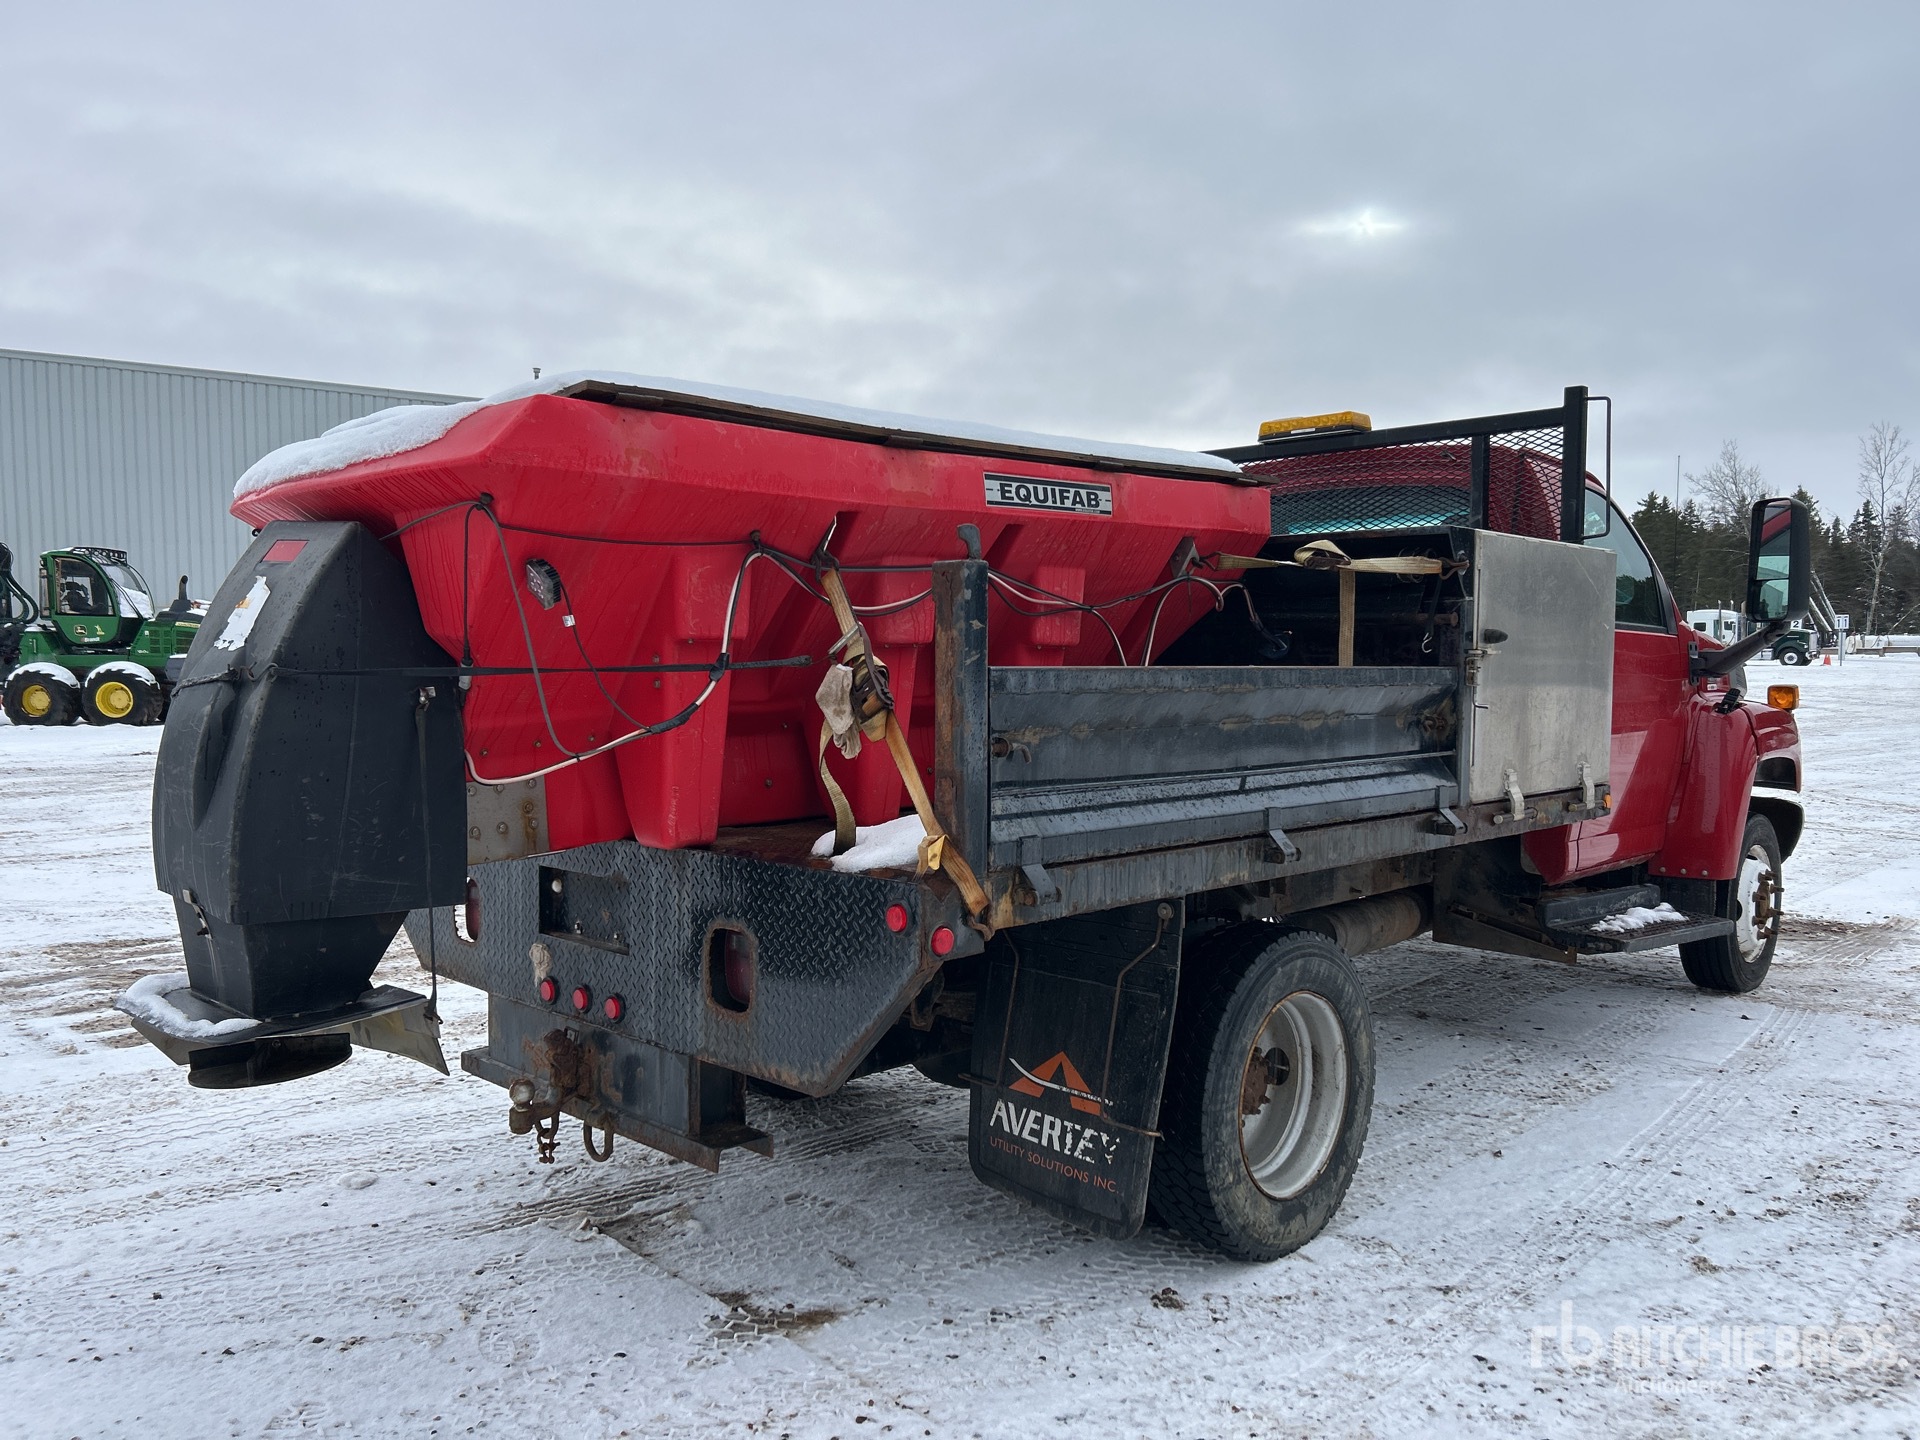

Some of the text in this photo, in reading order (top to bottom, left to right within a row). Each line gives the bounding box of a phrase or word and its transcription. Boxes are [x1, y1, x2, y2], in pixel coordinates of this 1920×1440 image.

[999, 482, 1100, 509] EQUIFAB
[989, 1136, 1026, 1159] UTILITY
[1027, 1151, 1089, 1184] SOLUTIONS
